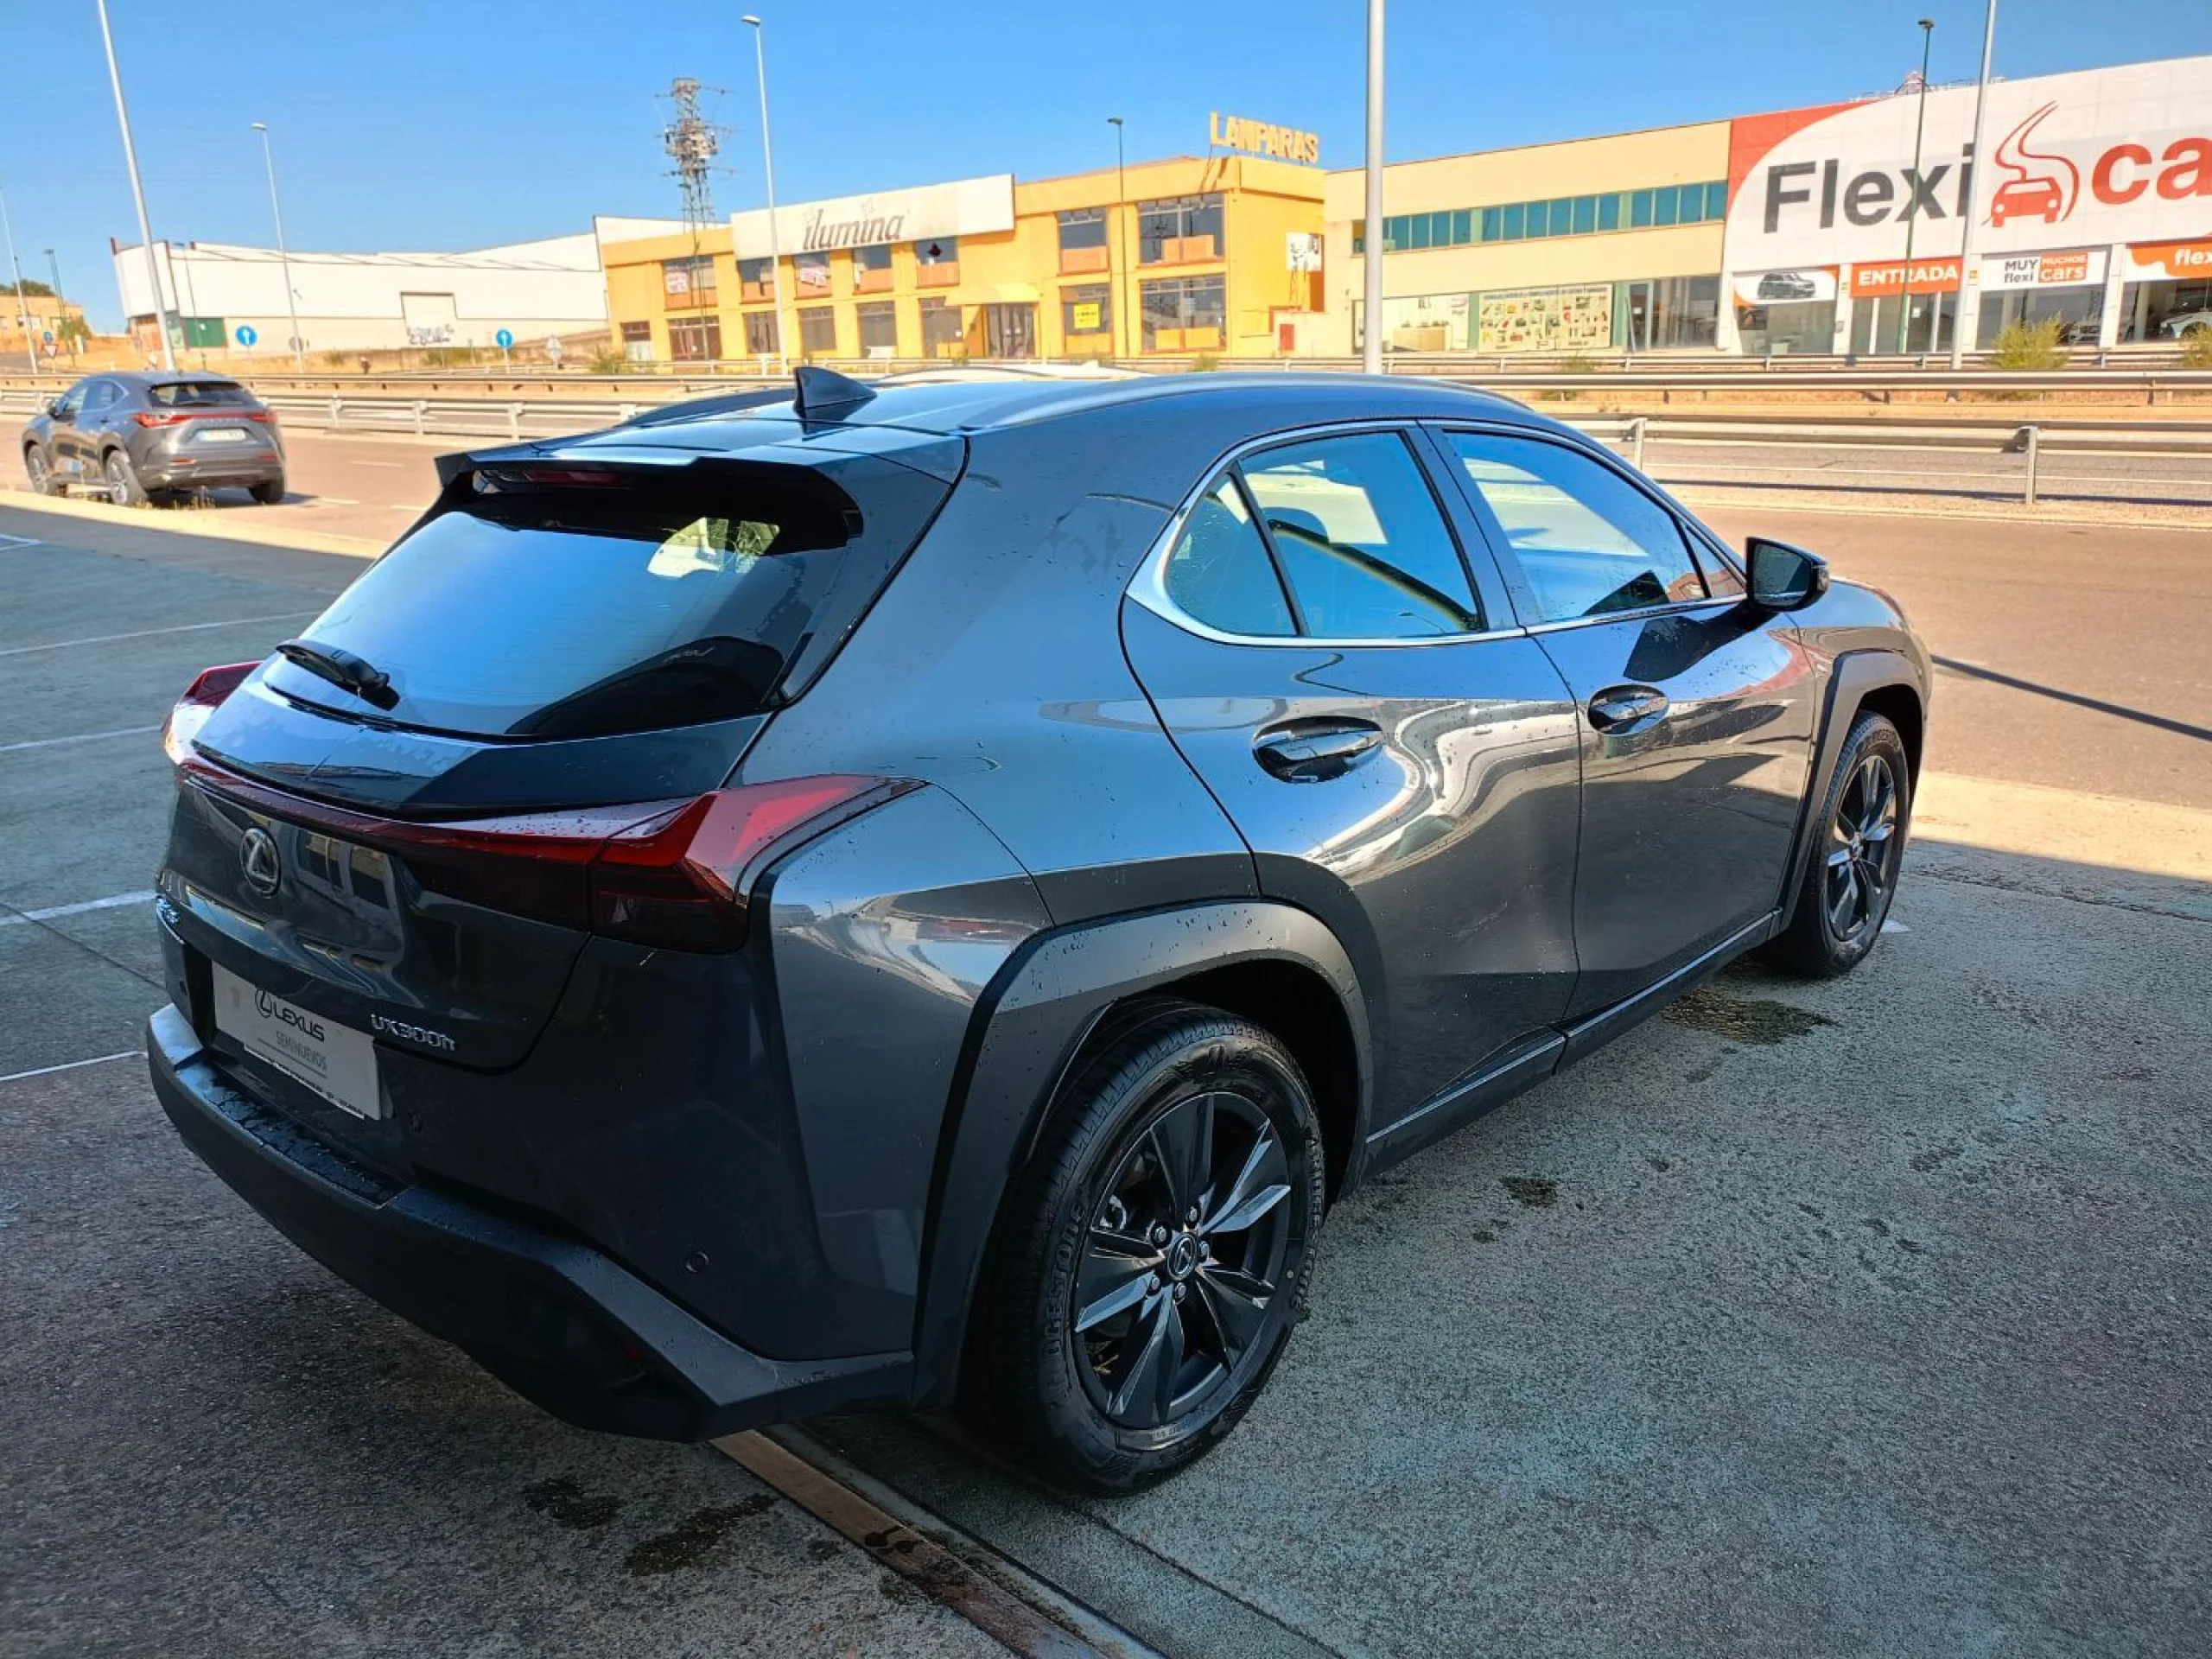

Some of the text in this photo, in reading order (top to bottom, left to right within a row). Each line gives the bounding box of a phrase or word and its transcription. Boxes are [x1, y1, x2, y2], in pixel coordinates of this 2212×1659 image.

[1210, 111, 1319, 163] LAMPARAS
[1763, 137, 2212, 234] Flexi ca
[803, 204, 906, 250] ilumina
[1858, 264, 1959, 286] ENTRADA
[2004, 258, 2038, 271] MUY
[2004, 266, 2086, 283] flexi cars
[273, 1001, 325, 1043] LEXUS
[276, 1031, 329, 1071] SEMINUEVOS
